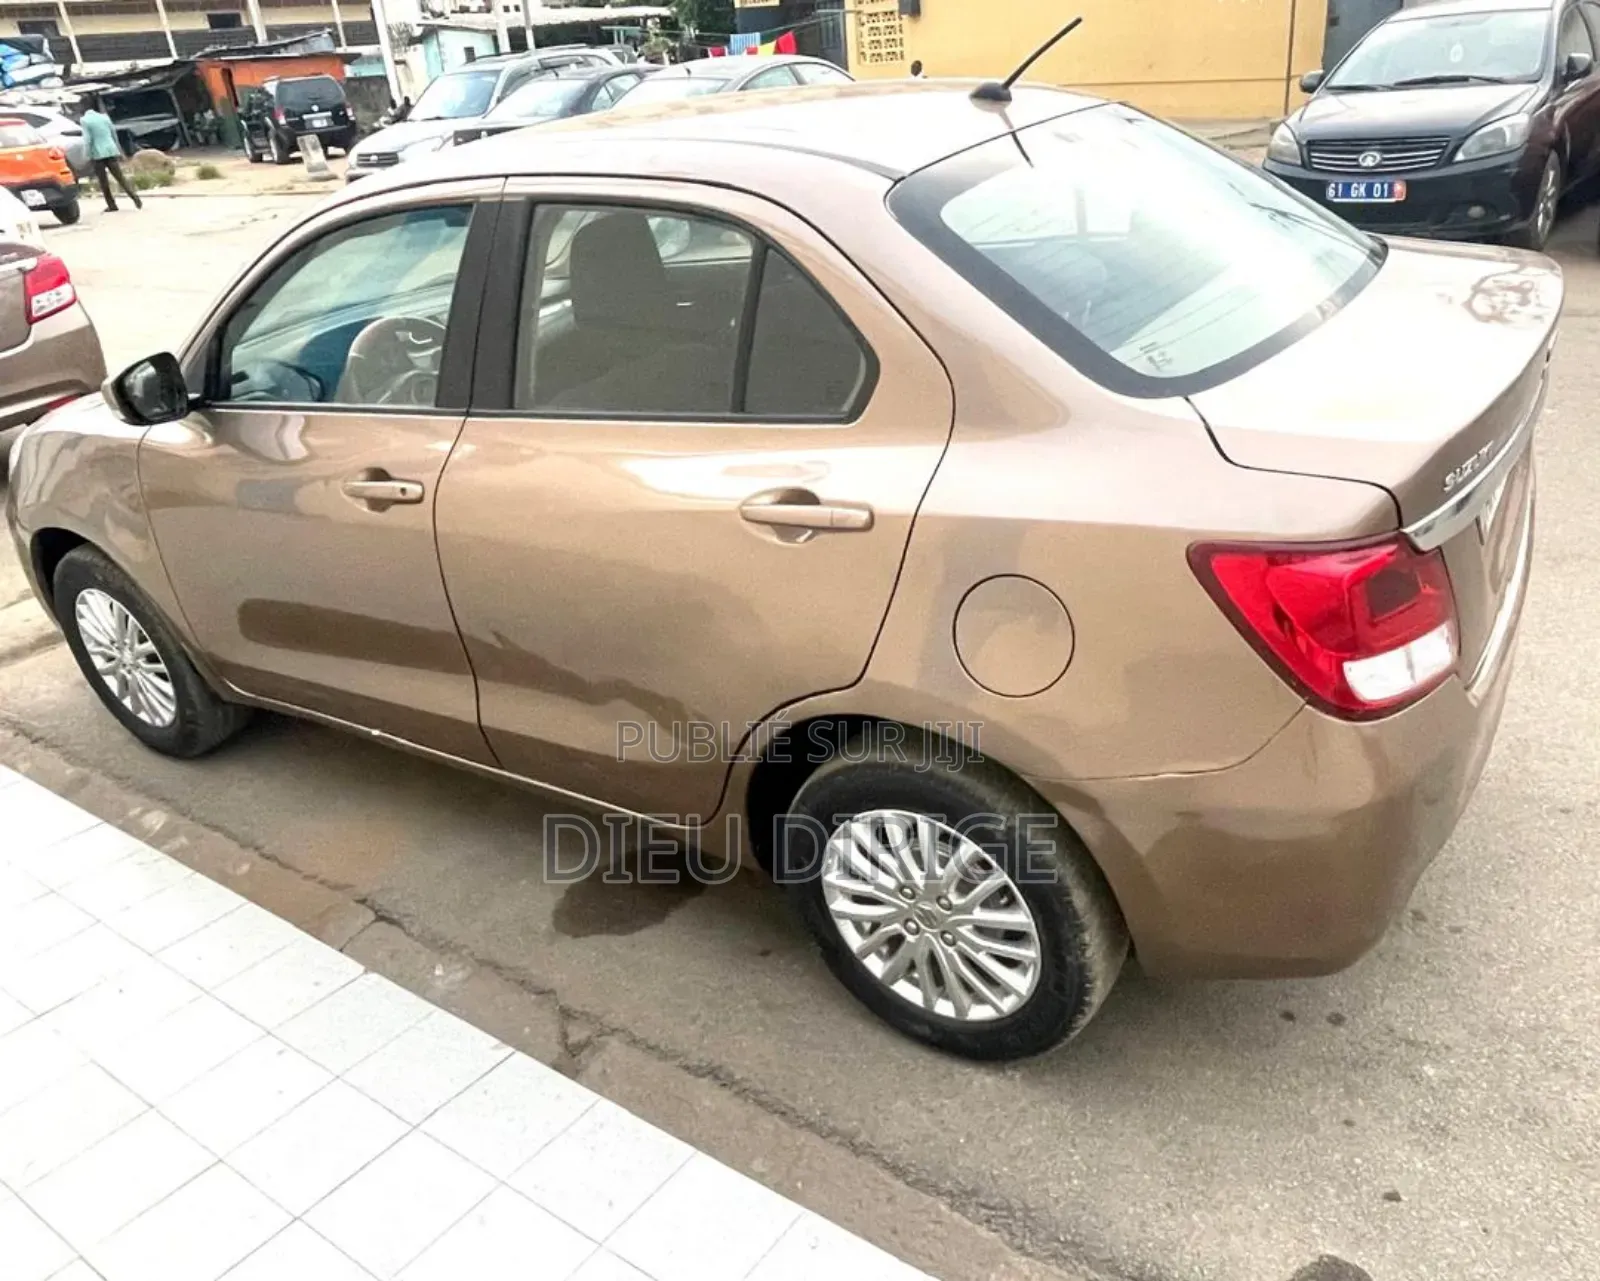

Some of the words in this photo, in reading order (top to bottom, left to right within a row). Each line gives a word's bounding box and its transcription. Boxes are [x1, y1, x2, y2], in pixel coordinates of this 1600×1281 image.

[1328, 183, 1343, 198] 61
[1350, 183, 1367, 198] GK
[1373, 183, 1389, 198] 01
